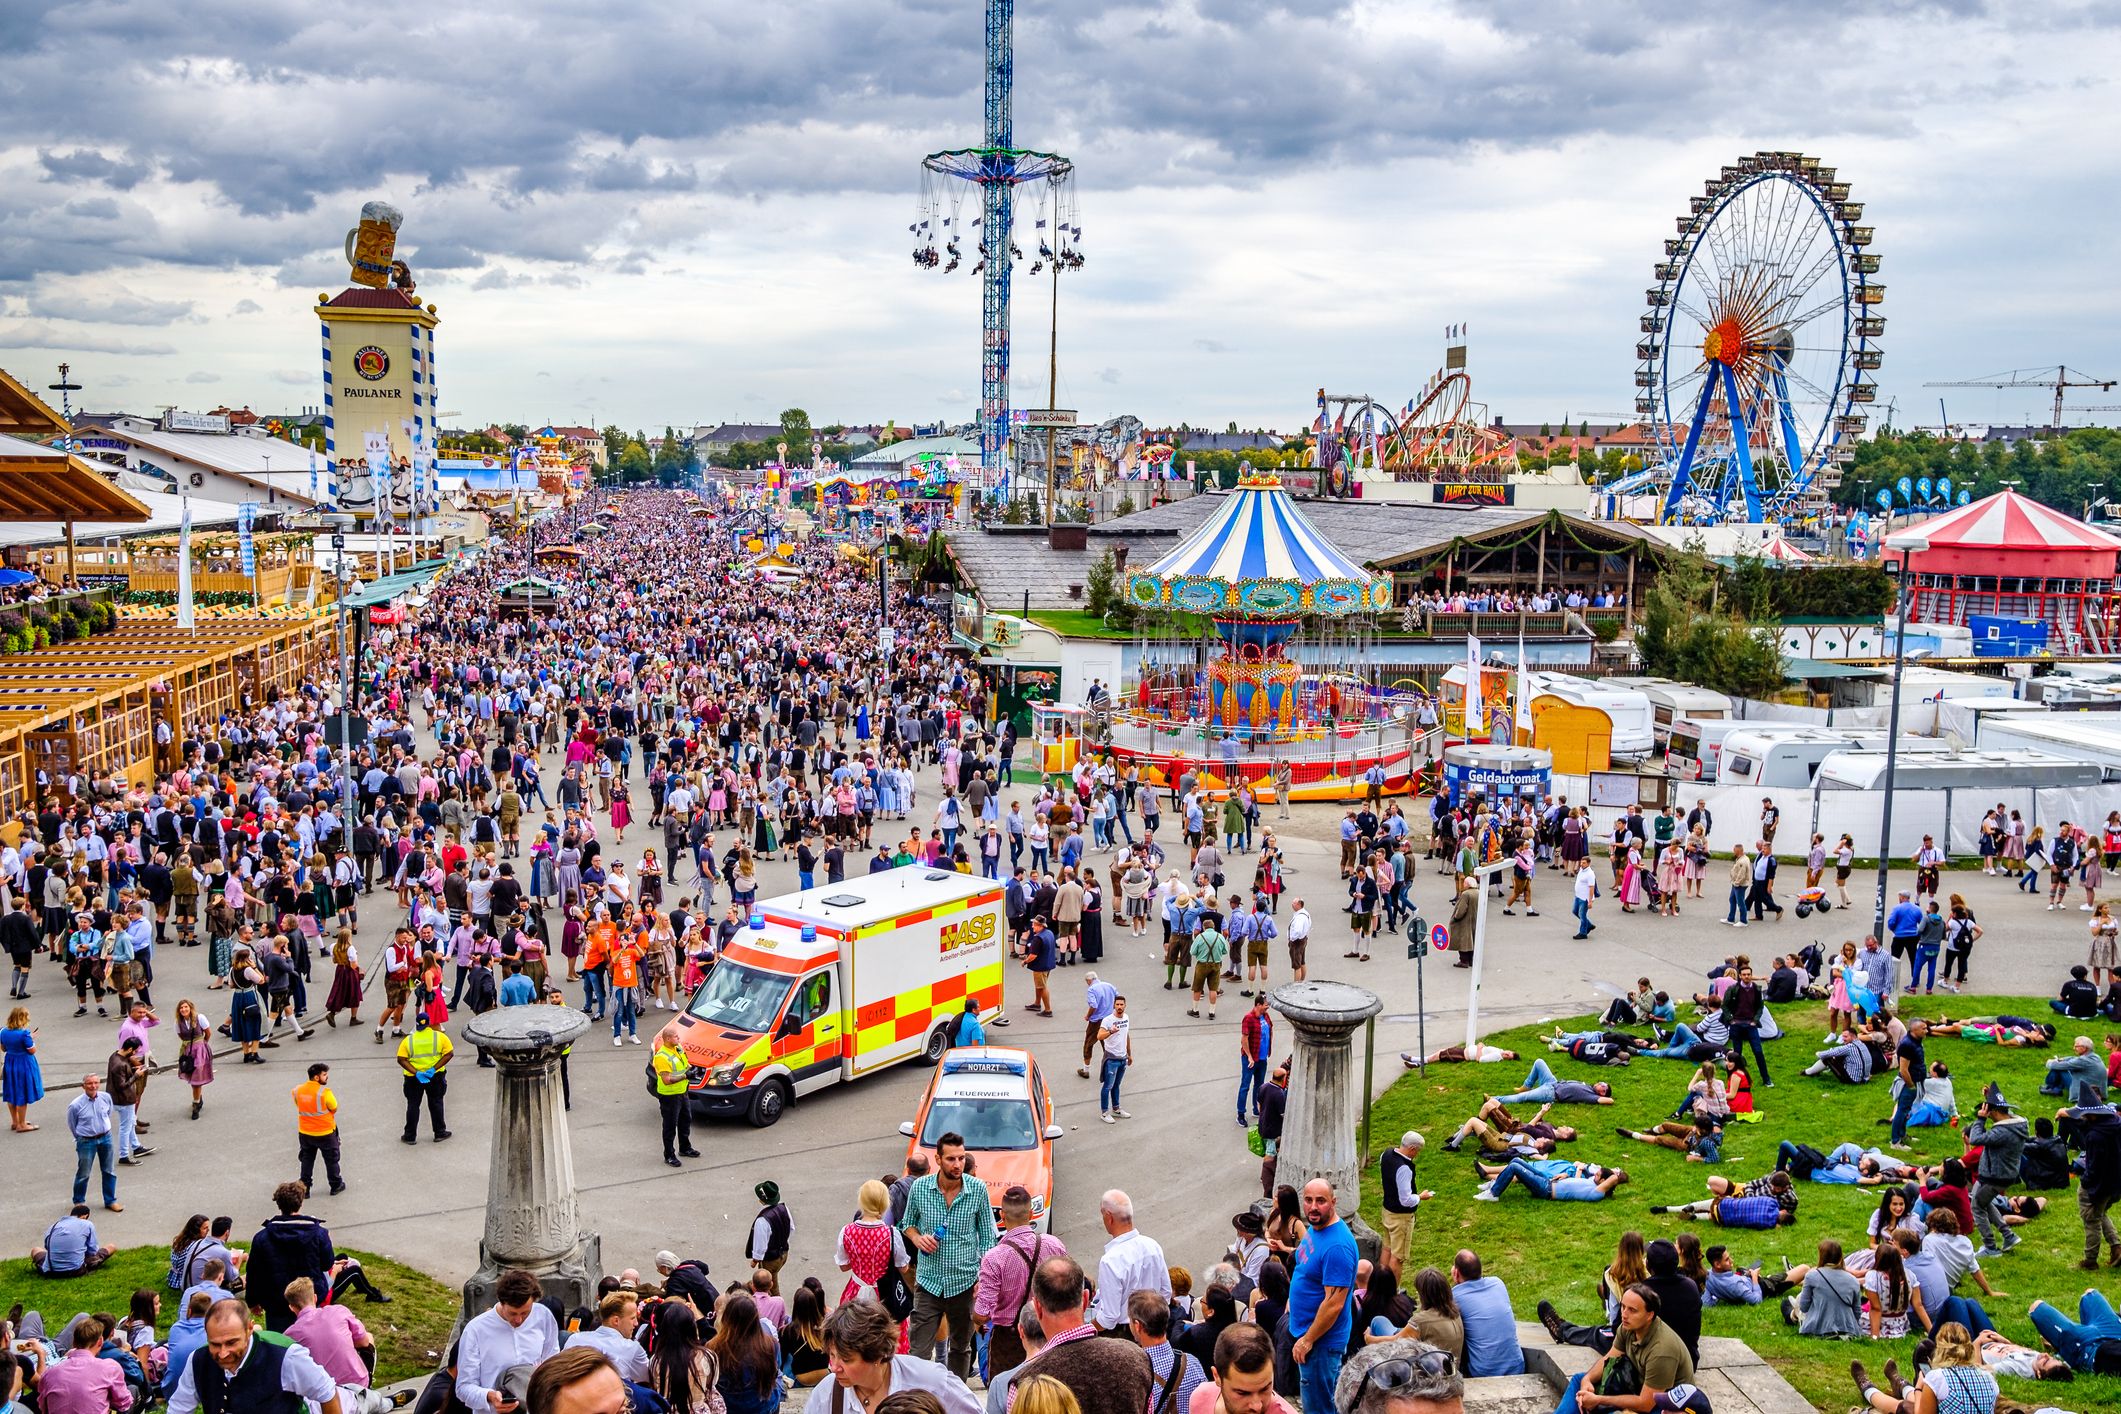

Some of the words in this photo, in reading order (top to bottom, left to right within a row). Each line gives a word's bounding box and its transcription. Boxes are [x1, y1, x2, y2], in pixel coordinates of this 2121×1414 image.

[355, 346, 388, 360] PAULANER
[344, 388, 402, 398] PAULANER
[80, 438, 129, 451] WENBRÄU
[911, 461, 940, 476] BREAK
[919, 469, 947, 486] DANCE
[1443, 485, 1467, 503] FAHRT
[1467, 485, 1482, 495] ZUR
[1468, 769, 1541, 784] Geldautomat
[953, 912, 997, 950] ASB
[940, 940, 996, 962] Arbeiter-Samariter-Bund
[875, 1006, 888, 1019] 112
[967, 1063, 1000, 1072] NOTARZT
